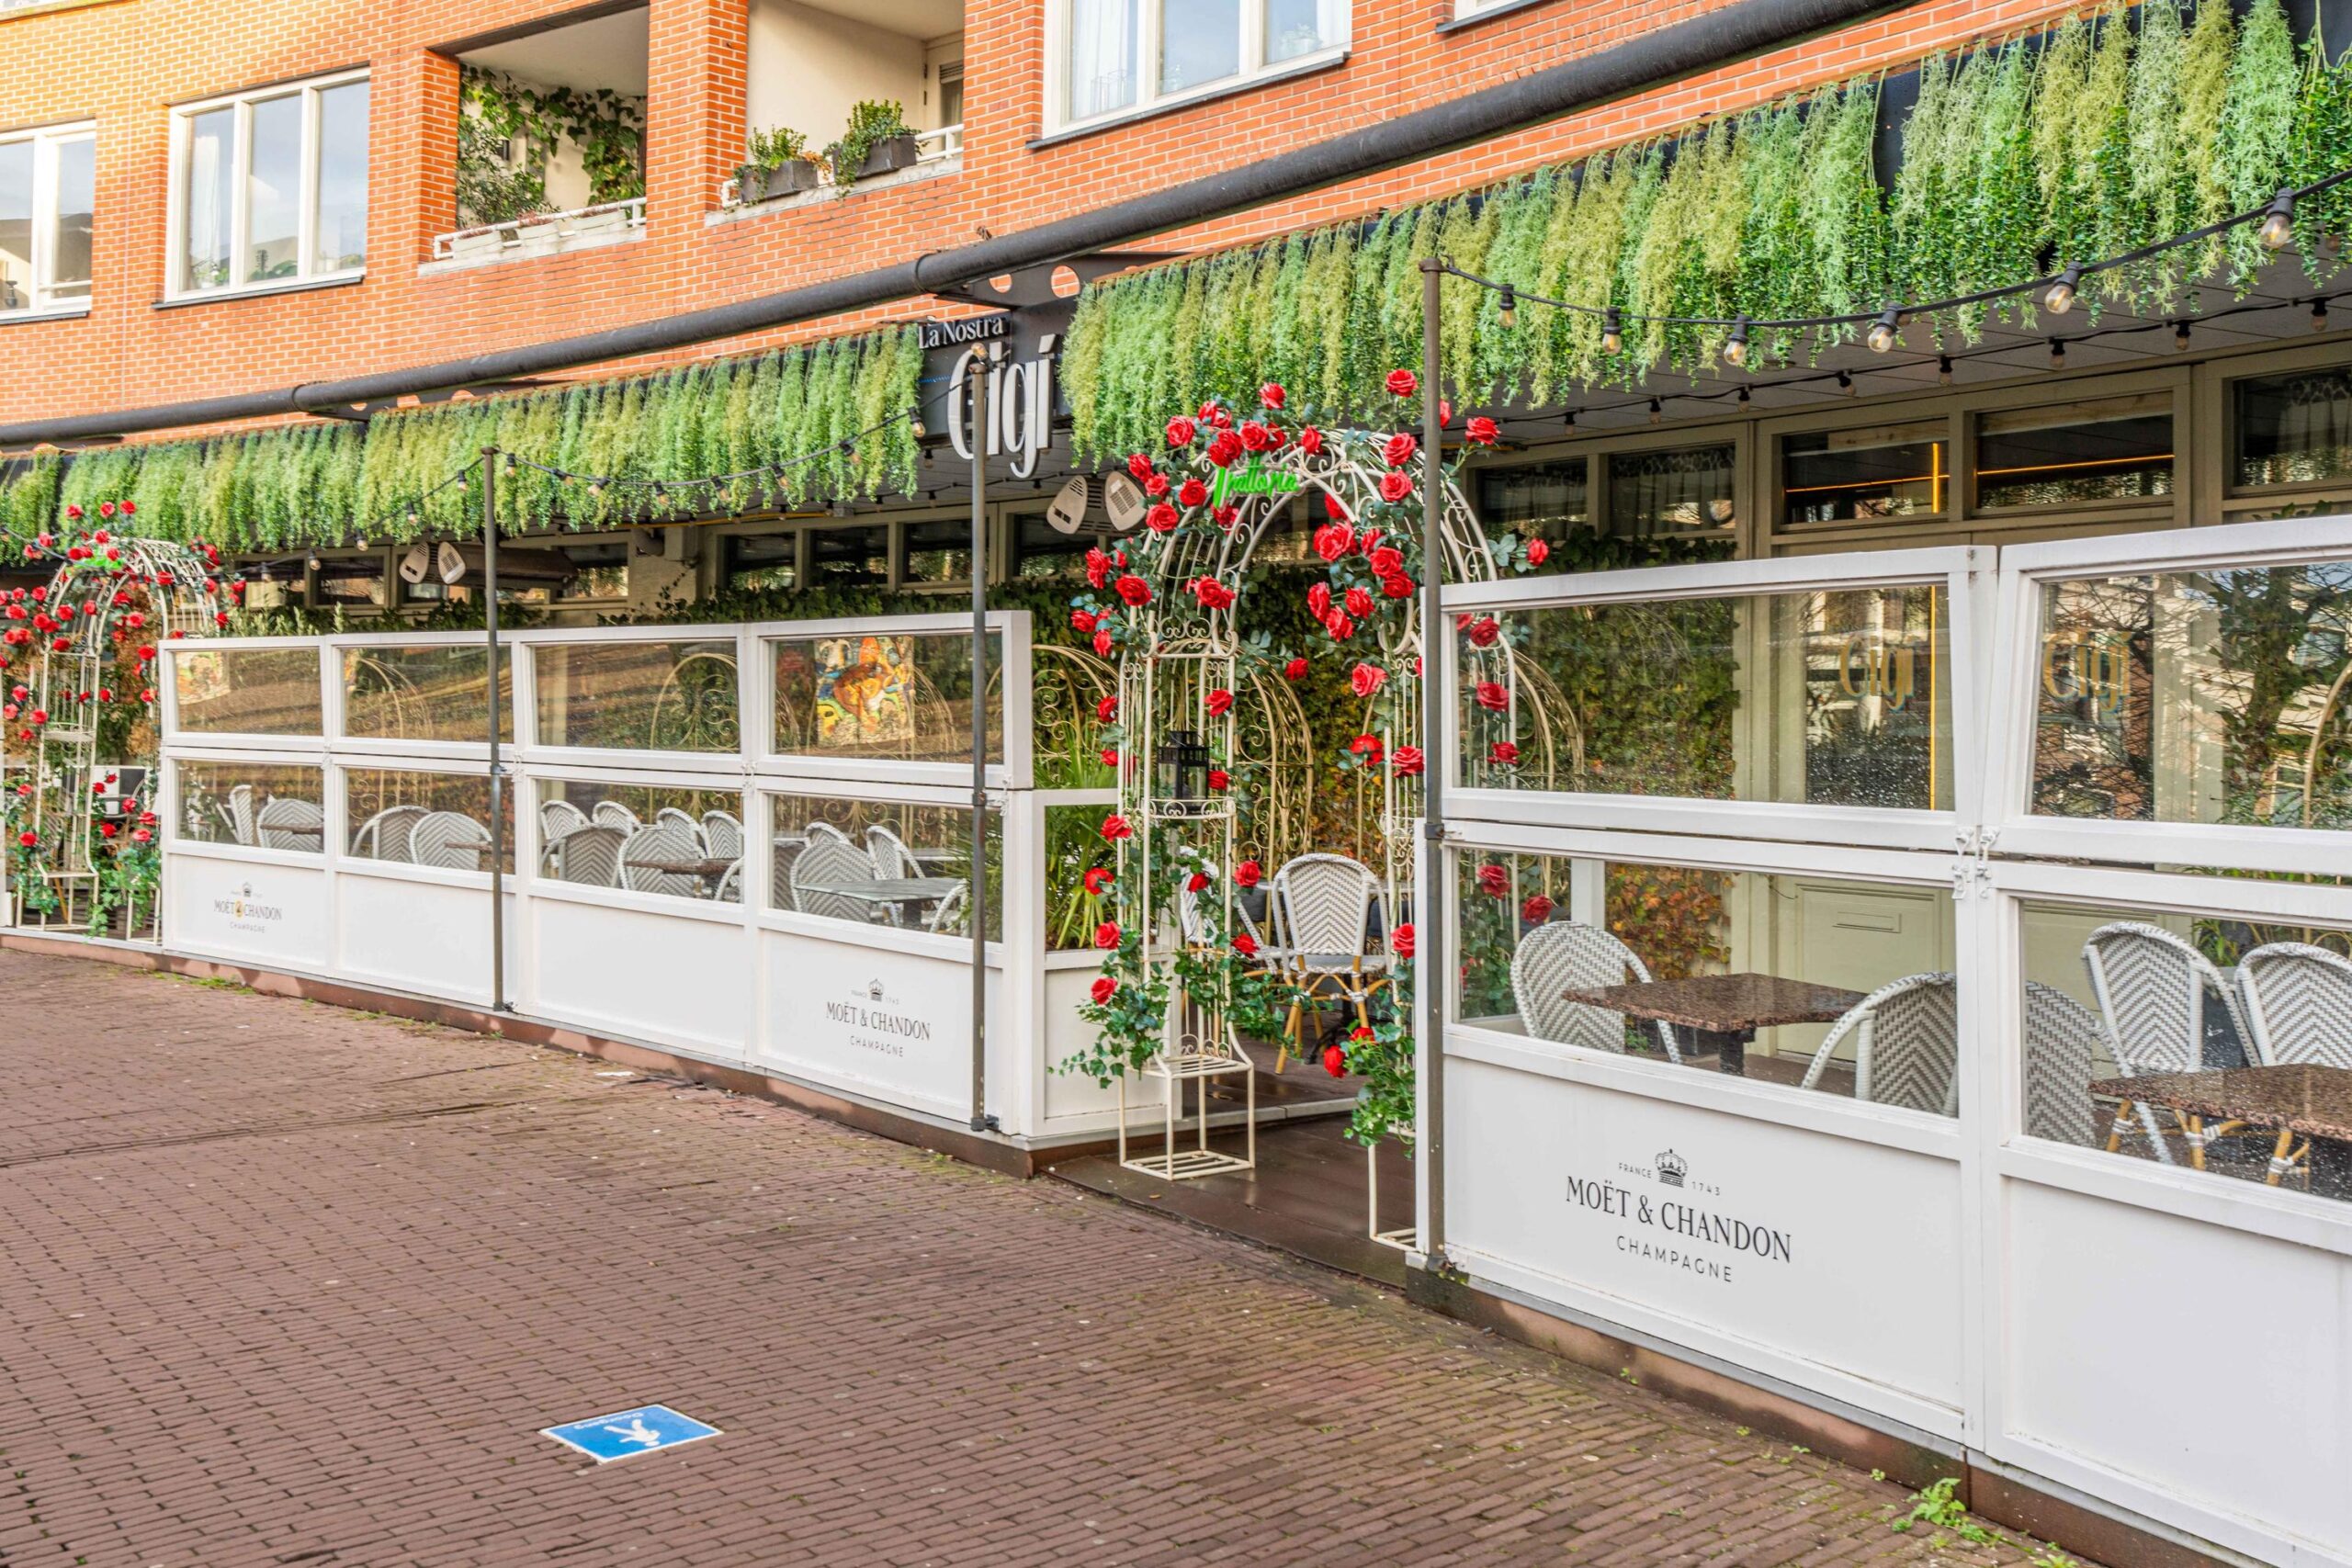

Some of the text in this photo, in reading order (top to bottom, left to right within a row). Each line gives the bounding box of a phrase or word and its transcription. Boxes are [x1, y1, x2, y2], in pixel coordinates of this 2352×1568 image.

[919, 316, 1005, 349] La Nostra
[826, 1001, 931, 1041] MOËT & CHANDON
[850, 1035, 904, 1057] CHAMPAGNE
[1618, 1162, 1721, 1196] FRANCE 1743
[1566, 1176, 1792, 1263] MOËT & CHANDON
[1617, 1235, 1732, 1282] CHAMPAGNE
